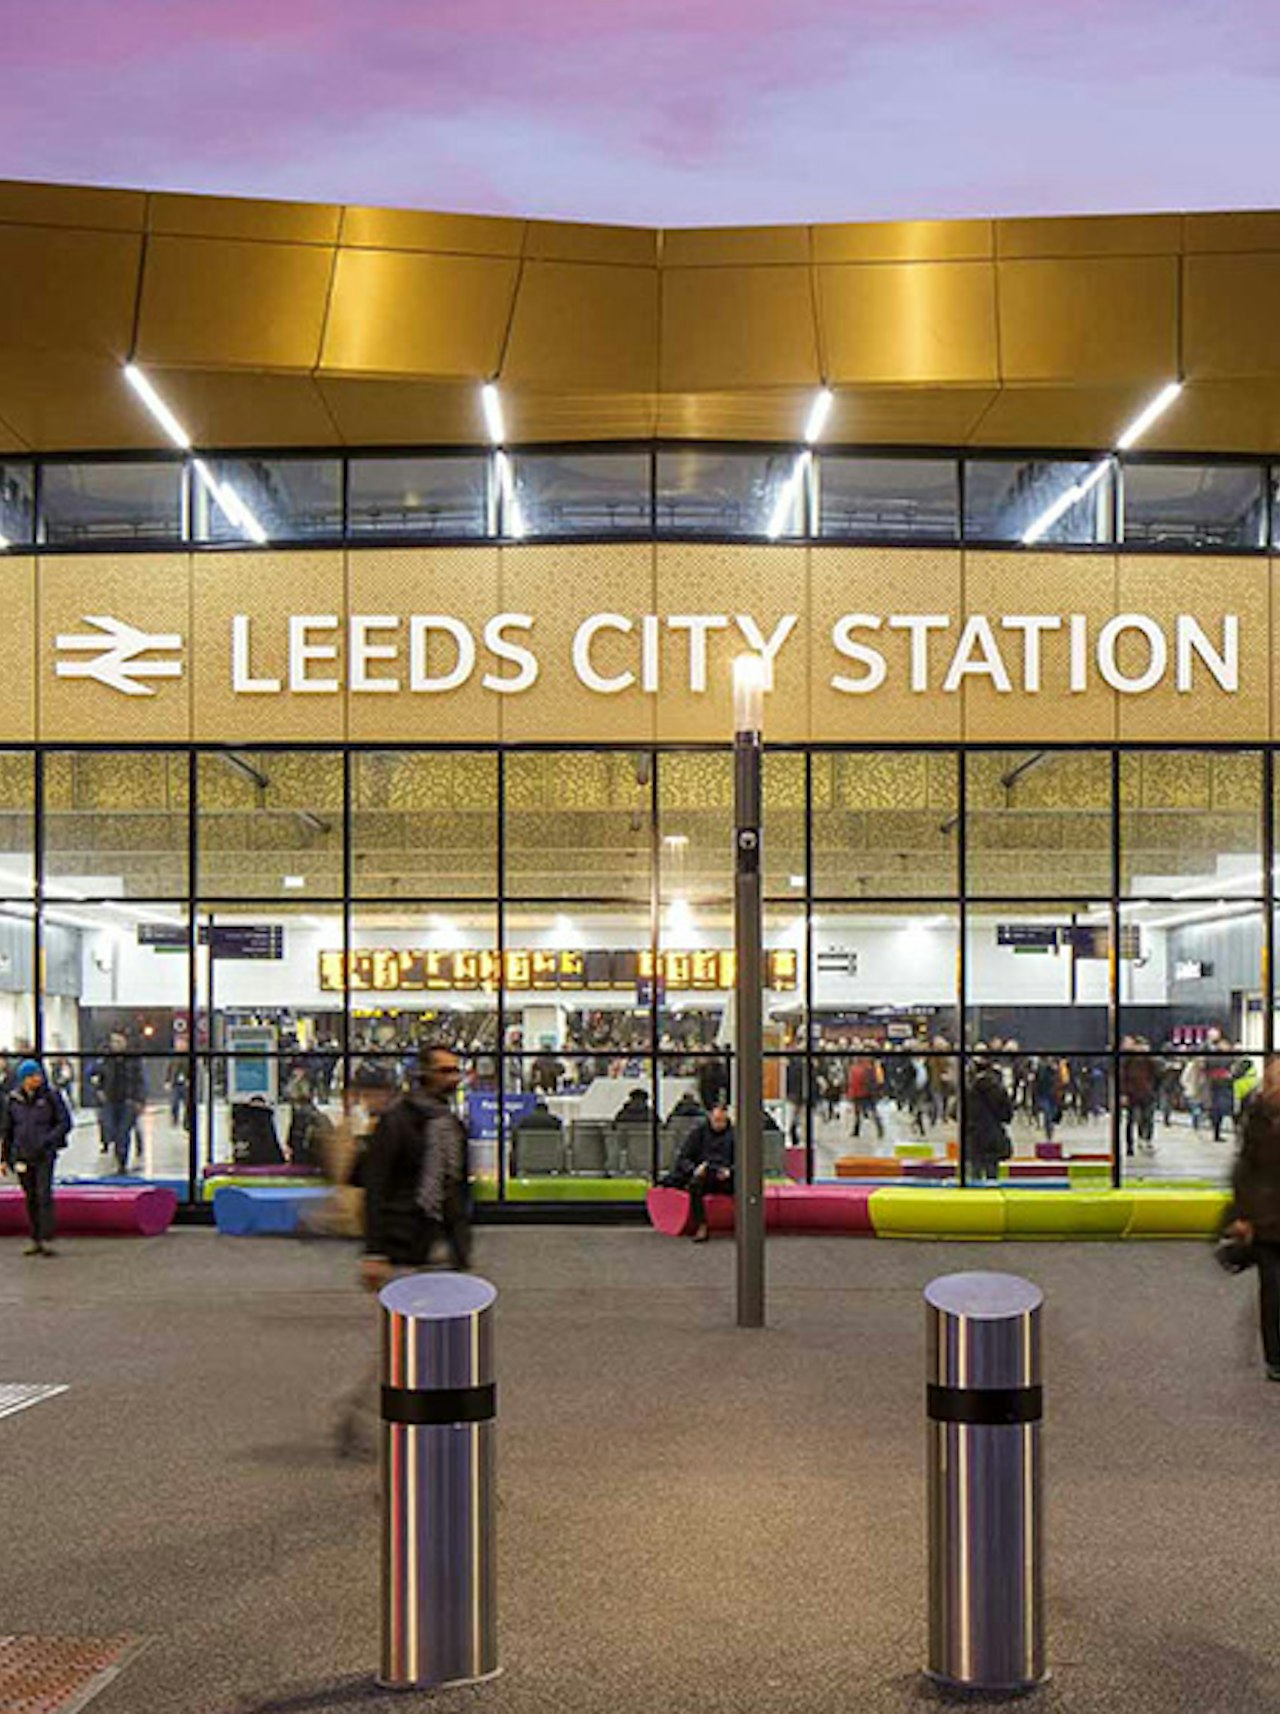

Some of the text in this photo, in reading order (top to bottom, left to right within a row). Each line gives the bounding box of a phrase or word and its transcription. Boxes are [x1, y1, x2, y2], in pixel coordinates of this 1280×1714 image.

[231, 613, 1240, 694] LEEDS CITY STATION
